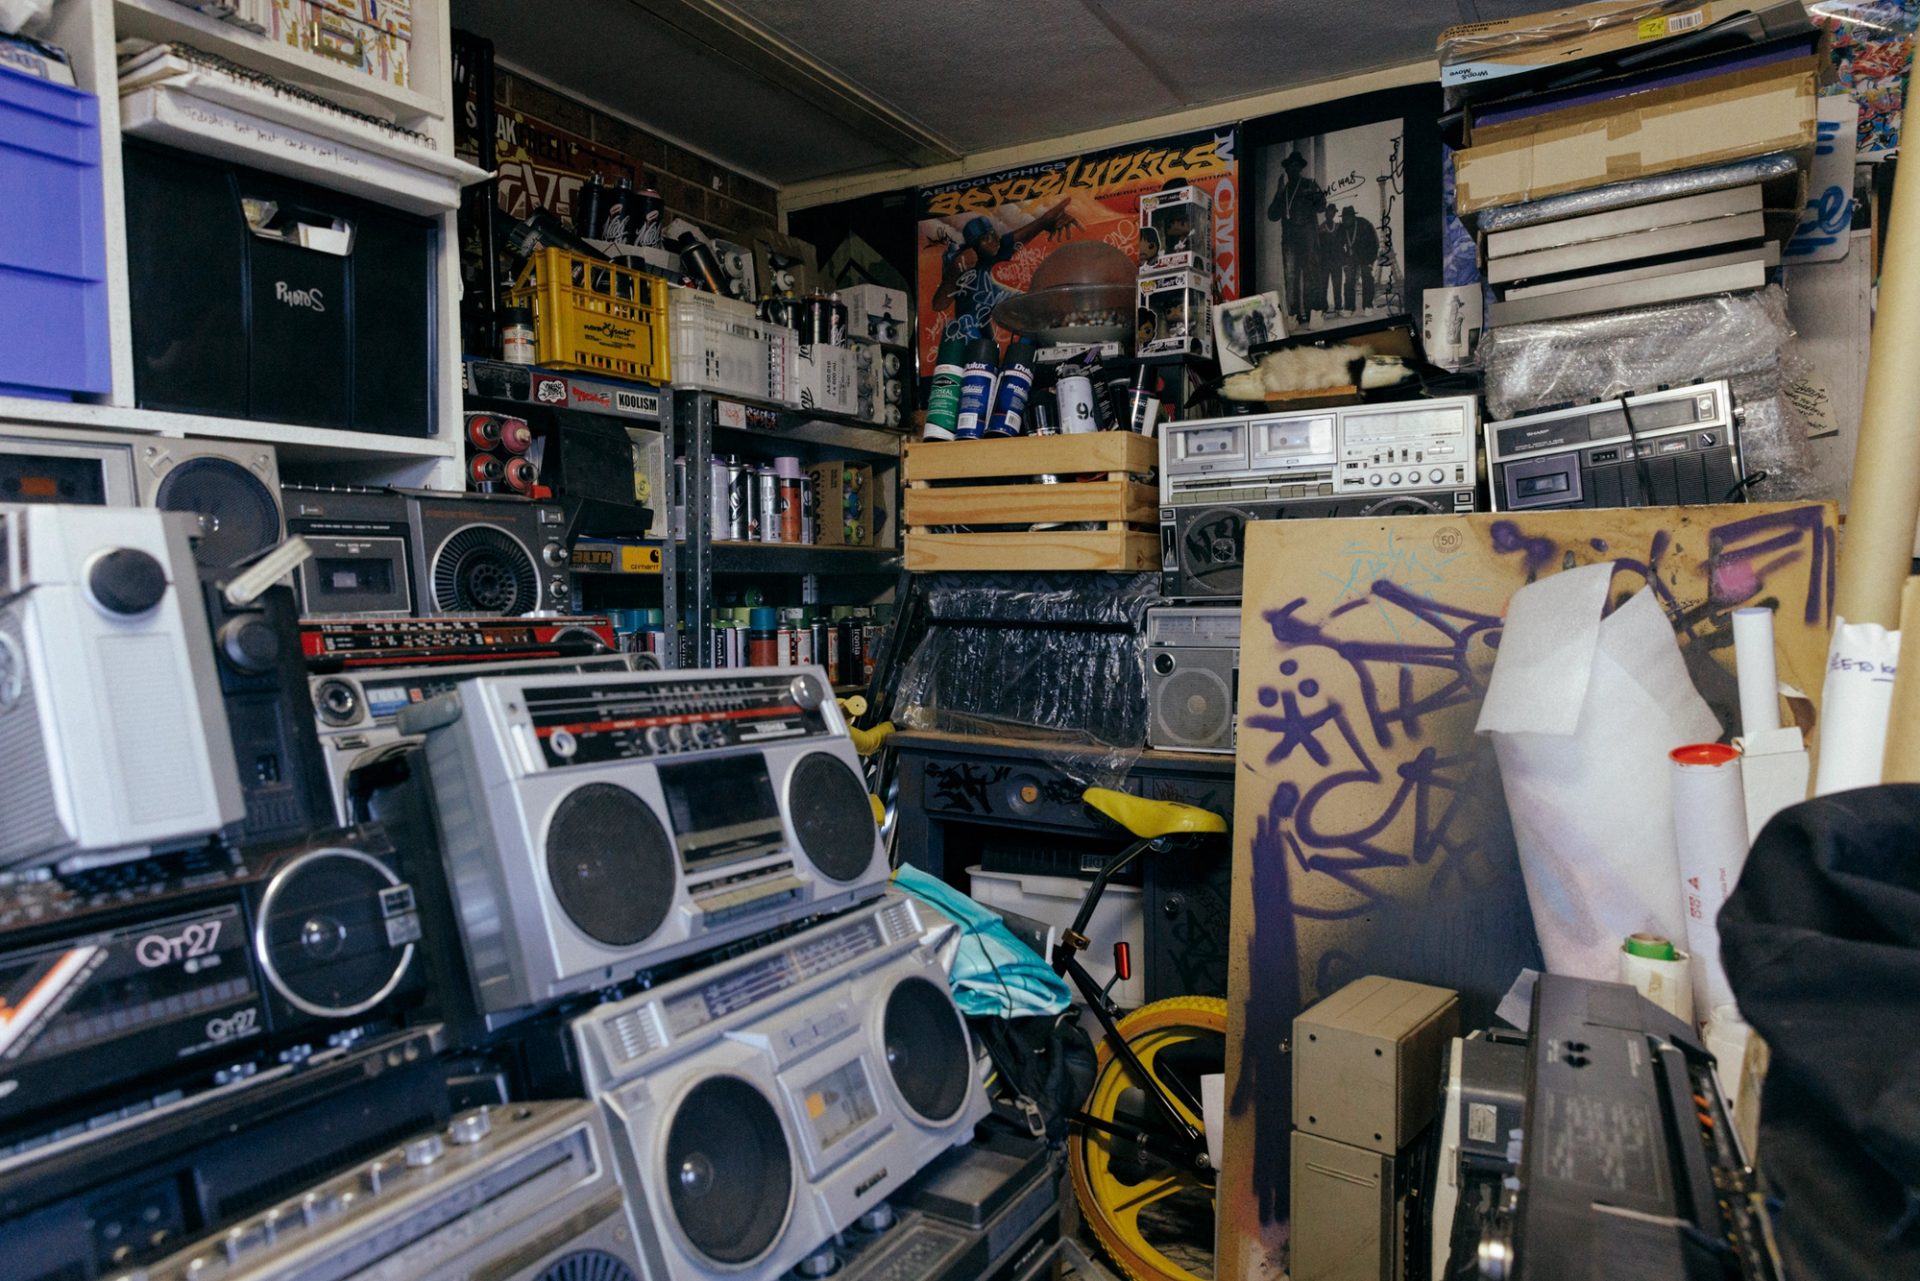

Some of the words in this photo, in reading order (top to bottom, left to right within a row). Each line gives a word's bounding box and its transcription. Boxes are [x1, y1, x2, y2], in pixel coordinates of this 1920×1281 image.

[1449, 67, 1472, 78] Move
[921, 161, 1067, 198] AEROGLYPHICS
[275, 281, 325, 312] PHOTOS
[618, 393, 657, 412] KOOLISM
[1441, 535, 1455, 546] 50
[136, 920, 222, 968] QT27
